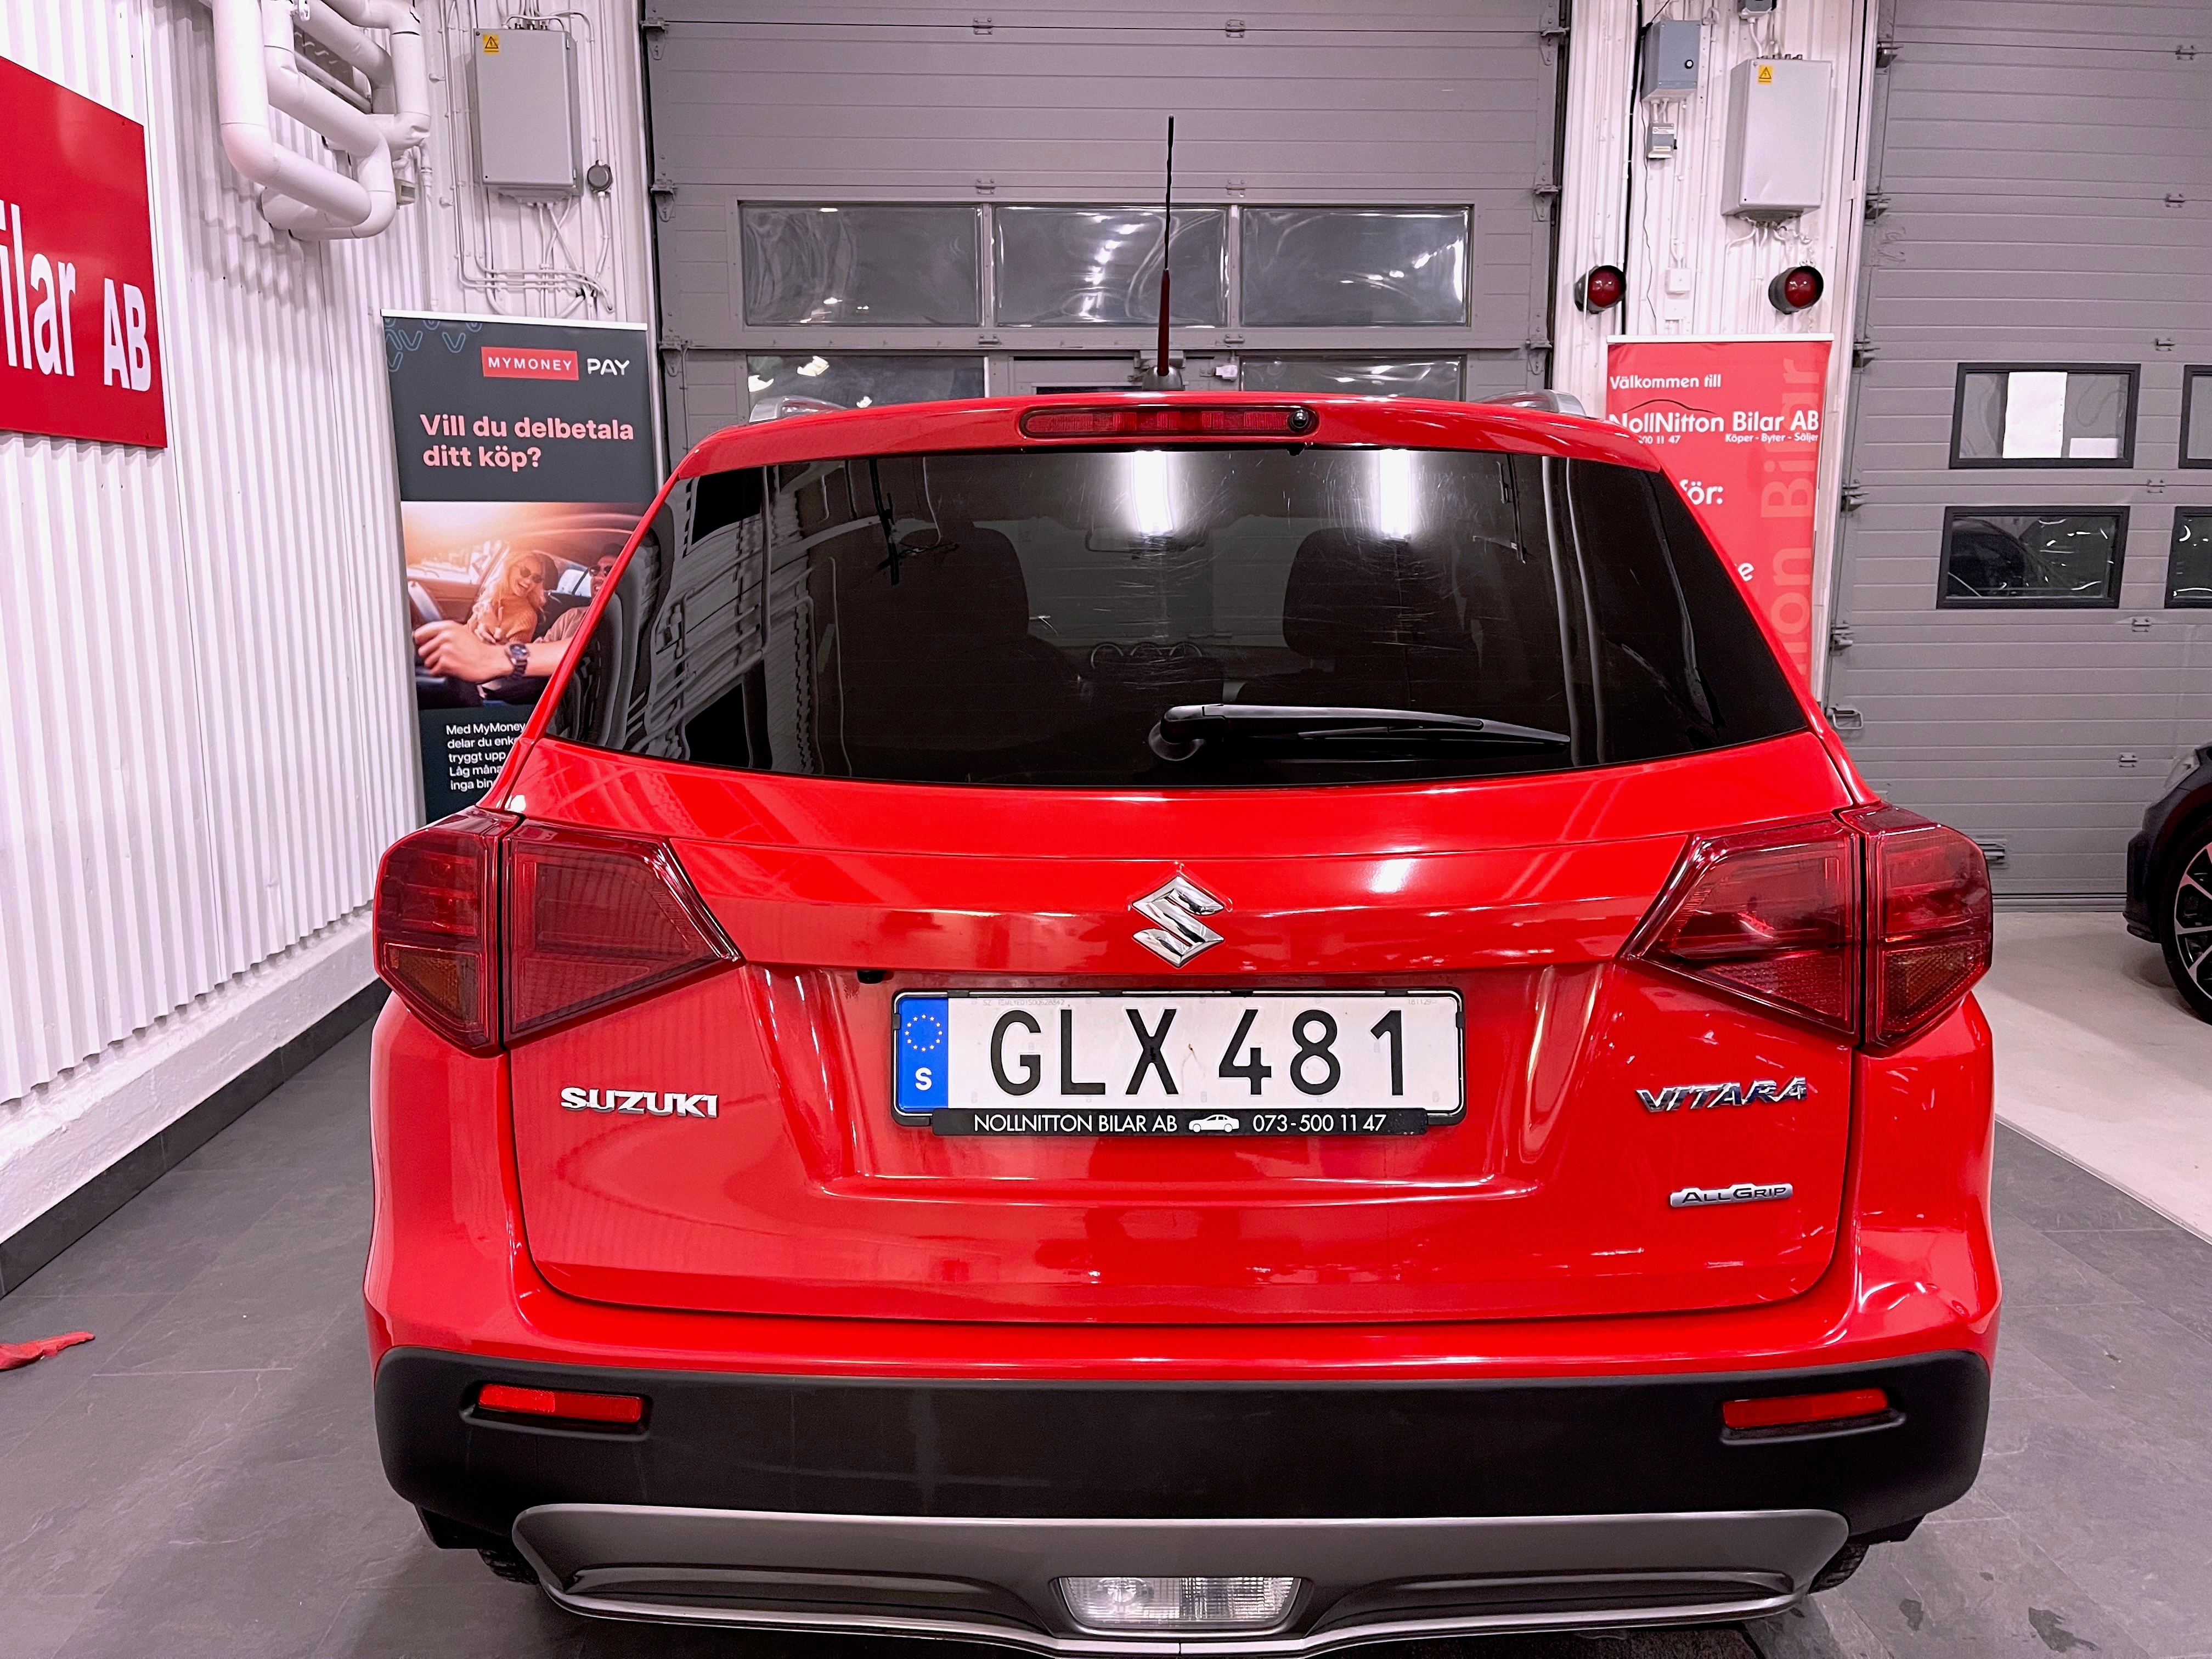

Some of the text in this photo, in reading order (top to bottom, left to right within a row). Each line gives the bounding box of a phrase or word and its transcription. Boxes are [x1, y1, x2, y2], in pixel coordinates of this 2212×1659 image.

[104, 277, 151, 392] AB
[488, 357, 630, 376] MYMONEY PAY
[1610, 374, 1722, 390] Välkommen till
[420, 414, 634, 440] Vill du delbetala
[1609, 410, 1819, 433] NollNitton Bilar AB
[1657, 435, 1664, 444] 11
[1668, 435, 1681, 444] 47
[1725, 433, 1753, 443] Köper
[1761, 434, 1786, 443] Byter
[1795, 432, 1819, 443] Säljer
[1761, 358, 1820, 518] Bilar
[423, 444, 542, 472] ditt köp?
[446, 723, 526, 735] Med MyMoney
[447, 738, 475, 749] delar
[477, 737, 492, 747] du
[448, 752, 506, 765] tryggt upp
[449, 766, 470, 778] Låg
[450, 778, 496, 792] inga bin
[990, 1008, 1403, 1096] GLX 481
[915, 1067, 933, 1091] S
[560, 1086, 719, 1119] SUZUKI
[1635, 1076, 1808, 1112] VITARA
[974, 1114, 1092, 1132] NOLLNITTON
[1099, 1114, 1147, 1132] BILAR
[1152, 1114, 1177, 1132] AB
[1341, 1114, 1356, 1132] 11
[1363, 1114, 1387, 1132] 47
